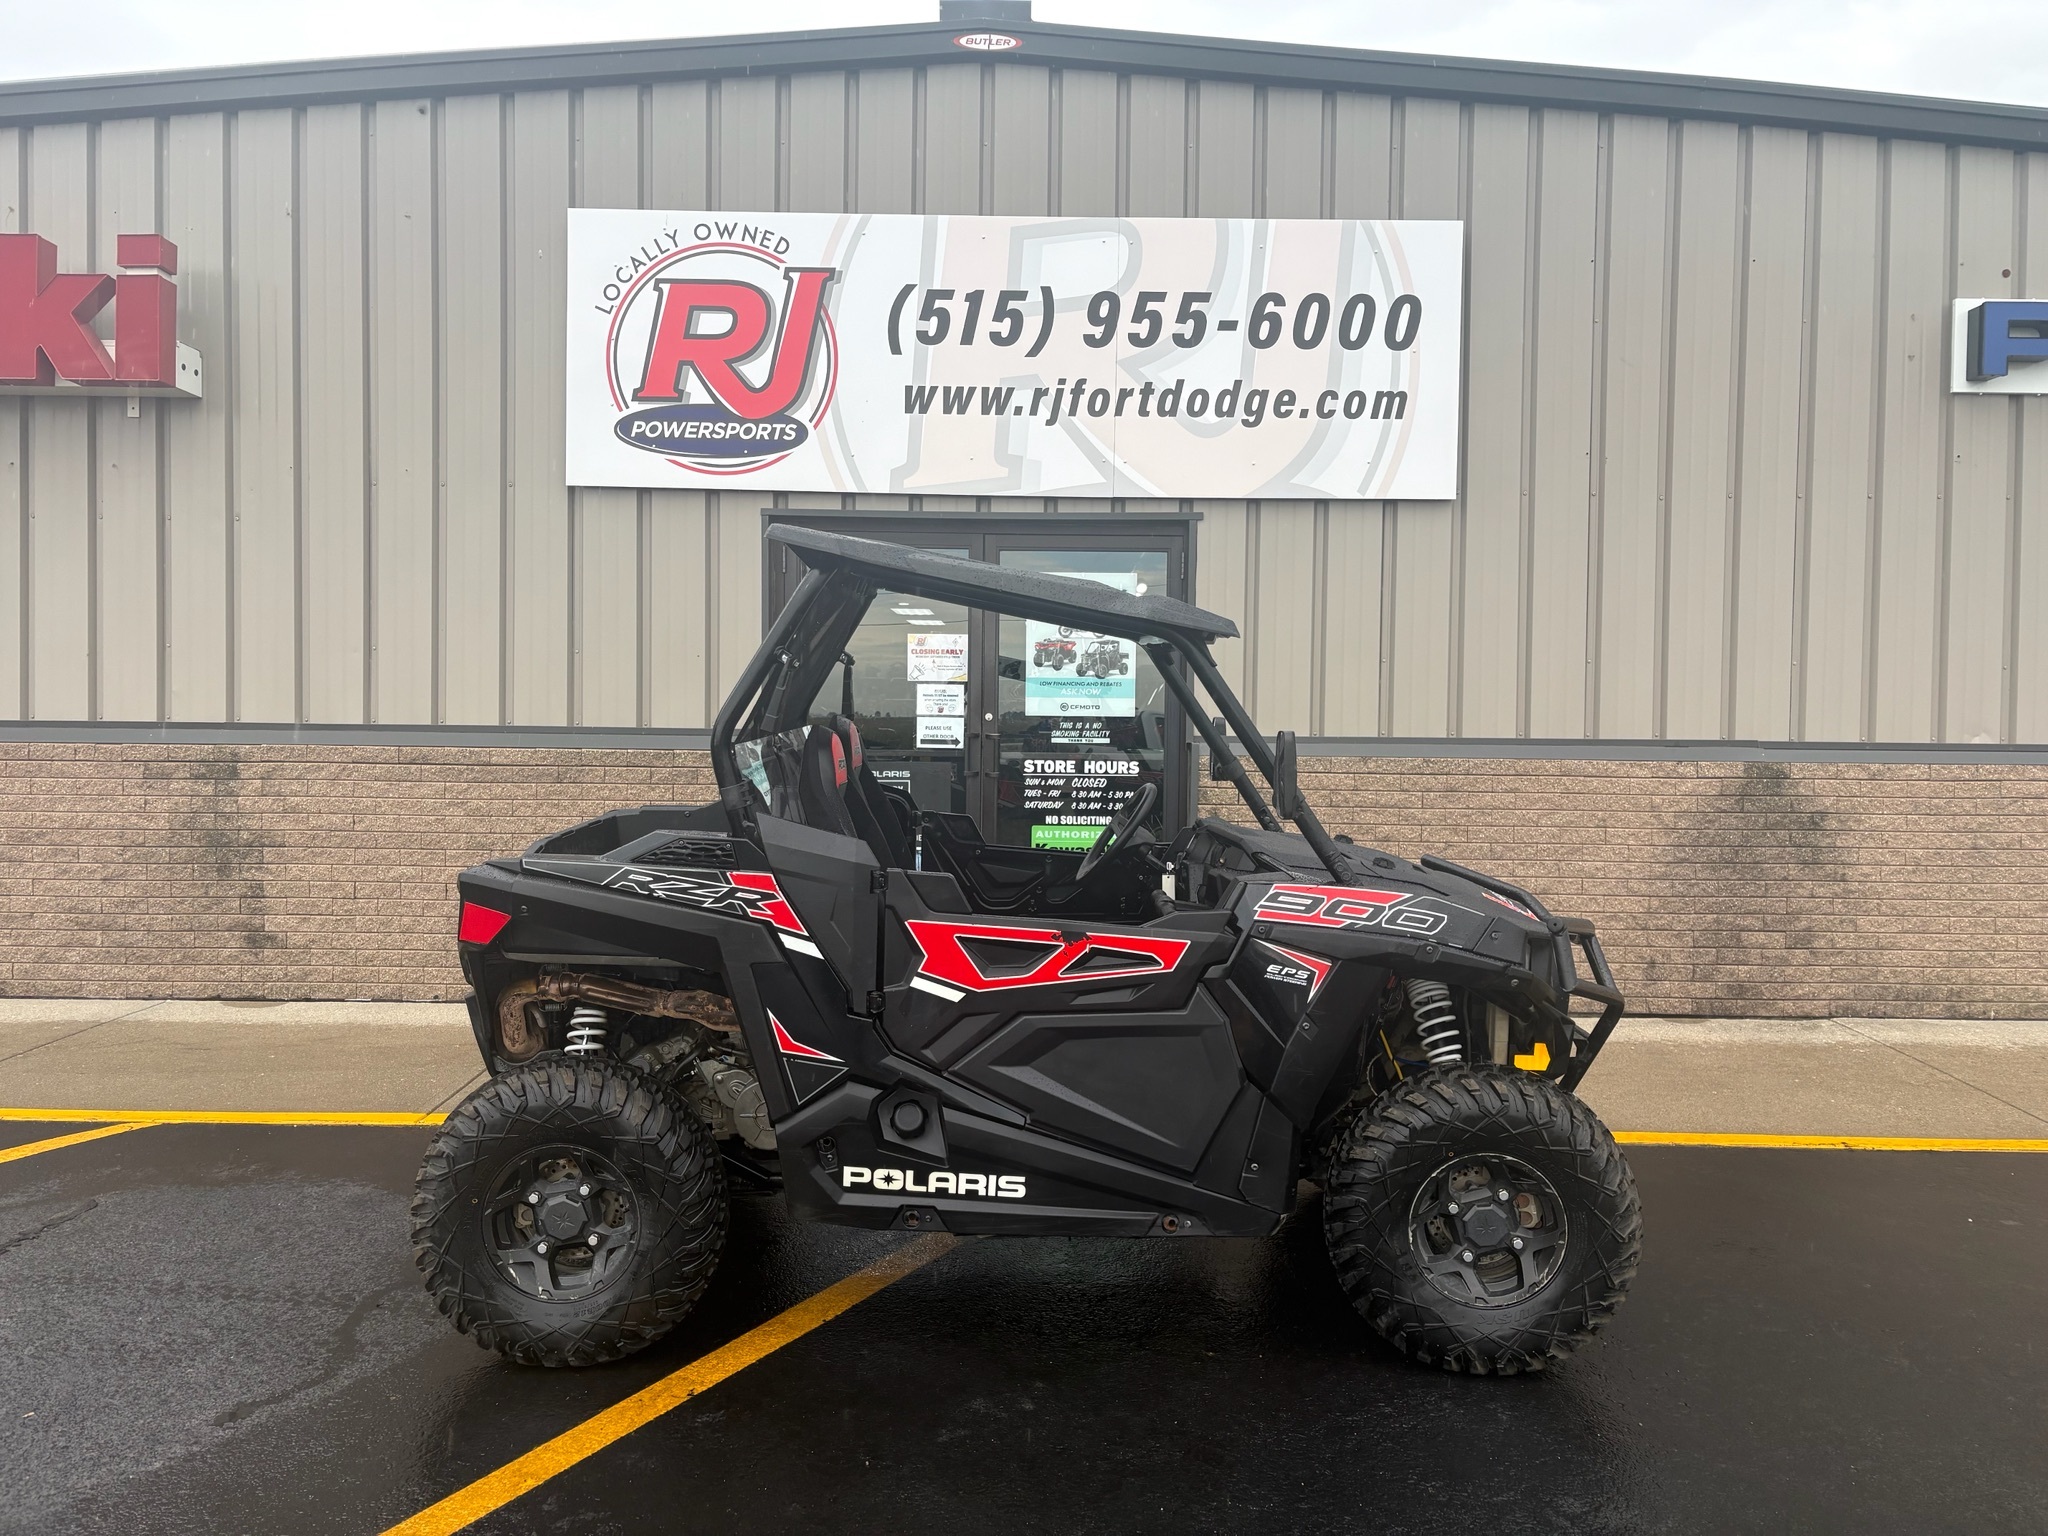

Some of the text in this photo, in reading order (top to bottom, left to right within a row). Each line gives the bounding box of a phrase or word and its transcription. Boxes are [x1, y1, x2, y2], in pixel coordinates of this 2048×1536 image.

[965, 37, 1012, 46] BUTLER
[594, 221, 791, 315] LOCALLY OWNED
[887, 283, 1423, 358] (515) 955-6000
[630, 266, 838, 420] RJ
[902, 377, 1409, 429] www.rjfortdodge.com
[630, 420, 798, 441] POWERSPORTS
[941, 648, 964, 656] EARLY
[1079, 688, 1101, 696] NOW
[1059, 721, 1073, 729] THIS
[1092, 722, 1103, 730] NO
[1081, 730, 1111, 738] FACILITY
[1023, 759, 1140, 774] STORE HOURS
[871, 770, 911, 778] LARIS
[1023, 778, 1041, 786] SUN
[1046, 778, 1066, 786] MON
[1071, 777, 1107, 788] CLOSED
[1023, 789, 1042, 797] TUES
[1047, 789, 1062, 797] FRI
[1087, 790, 1102, 798] AM
[1023, 801, 1064, 809] SATURDAY
[1087, 802, 1102, 810] AM
[1045, 815, 1113, 826] NO SOLICITING
[601, 866, 784, 917] RZR
[1253, 890, 1448, 936] 900
[1266, 964, 1311, 980] EPS
[842, 1165, 1027, 1199] POLARIS
